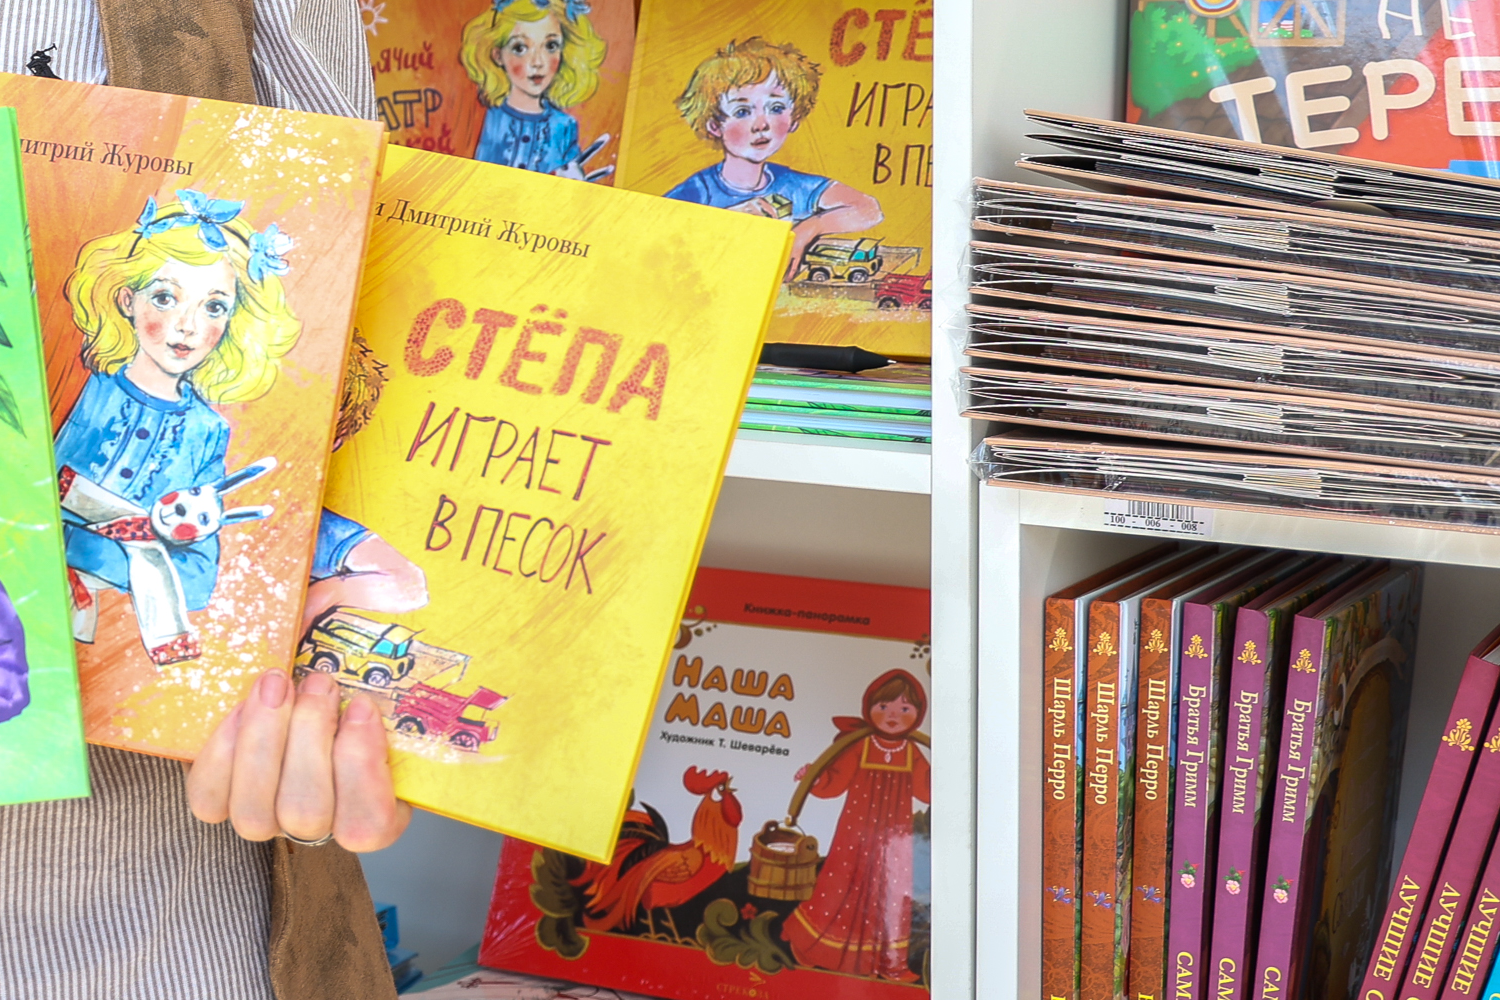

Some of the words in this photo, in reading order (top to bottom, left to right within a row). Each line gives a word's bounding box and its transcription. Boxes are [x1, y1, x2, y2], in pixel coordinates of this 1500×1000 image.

[100, 142, 194, 177] Журовы
[873, 143, 892, 185] В
[387, 198, 493, 238] Дмитрий
[496, 220, 591, 258] Журовы
[404, 298, 670, 421] СТЁПА
[405, 401, 612, 501] ИГРАЕТ
[425, 494, 458, 551] В
[461, 504, 607, 594] ПЕСОК
[743, 603, 871, 626] Книжка-панорамка
[672, 653, 795, 701] НАША
[1048, 677, 1072, 737] Шарль
[664, 692, 791, 739] МАША
[1091, 682, 1115, 743] Шарль
[1141, 678, 1166, 739] Шарль
[1182, 684, 1207, 746] Братья
[1233, 690, 1259, 752] Братья
[1287, 698, 1312, 760] Братья
[660, 730, 715, 748] Художник
[718, 738, 726, 749] Т.
[730, 740, 790, 757] Шеварёва
[1048, 743, 1071, 800] Перро
[1140, 744, 1165, 801] Перро
[1090, 747, 1114, 805] Перро
[1180, 749, 1204, 808] Гримм
[1229, 756, 1254, 814] Гримм
[1280, 763, 1305, 823] Гримм
[1373, 874, 1421, 981] ЛУЧШИЕ
[1412, 881, 1461, 989] ЛУЧШИЕ
[1451, 887, 1500, 995] ЛУЧШИЕ
